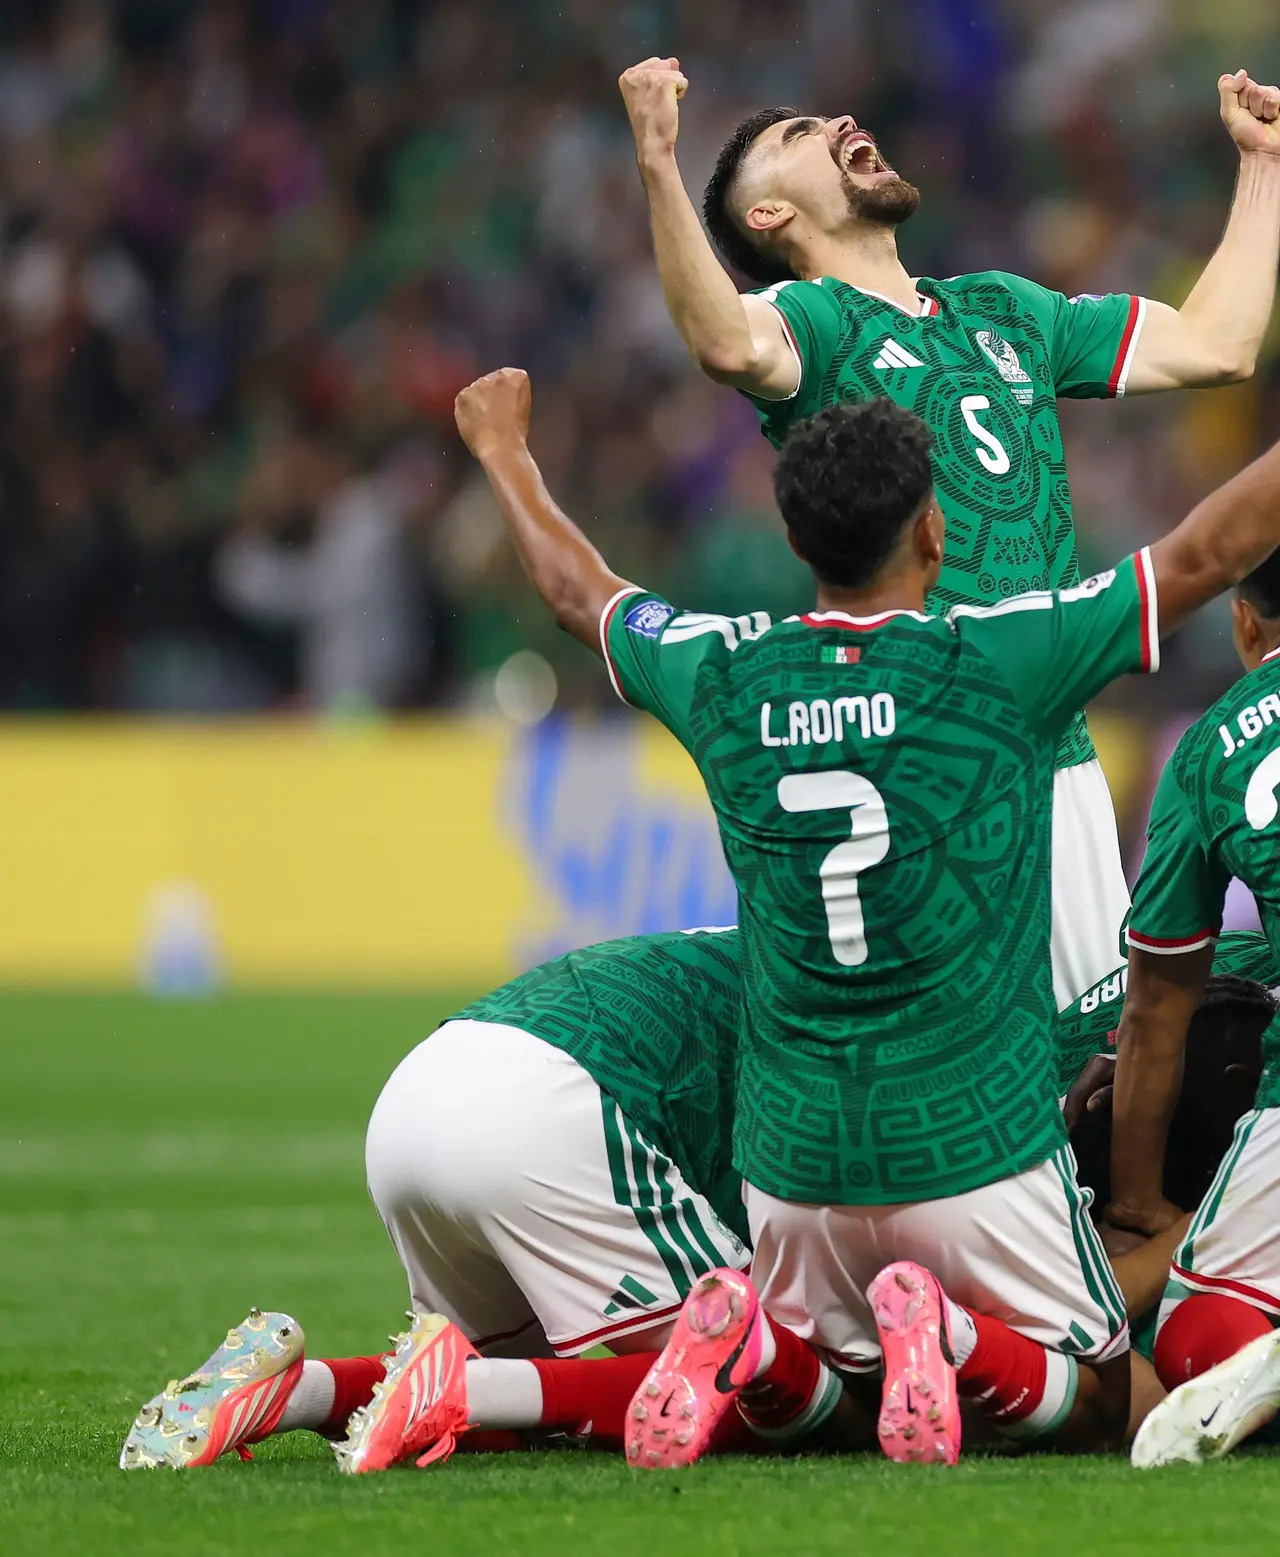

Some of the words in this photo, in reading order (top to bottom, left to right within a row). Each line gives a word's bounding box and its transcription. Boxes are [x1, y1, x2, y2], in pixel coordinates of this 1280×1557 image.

[960, 395, 1010, 474] 5
[761, 692, 896, 747] L.ROMO
[777, 770, 890, 966] 7
